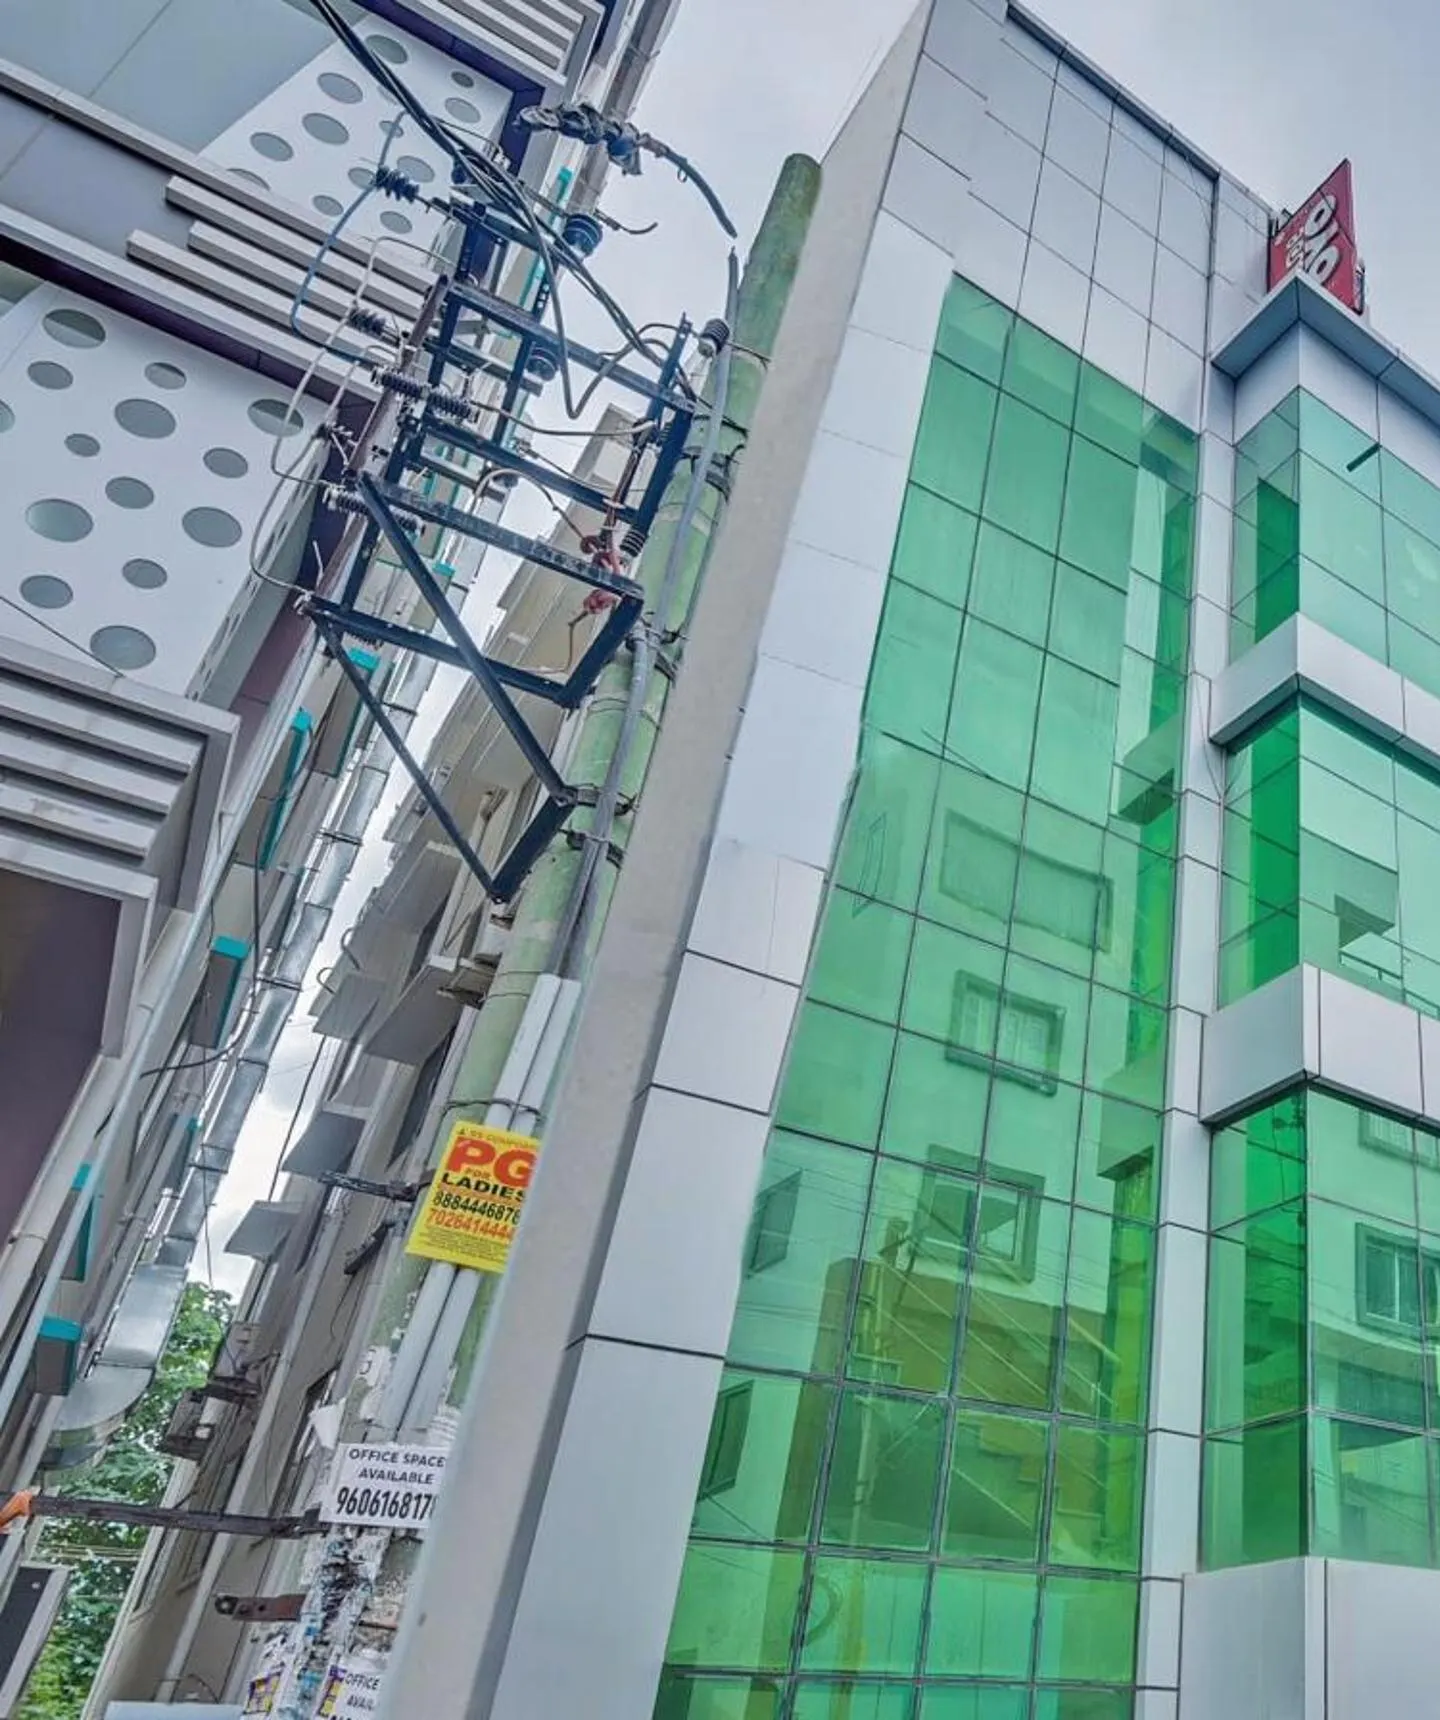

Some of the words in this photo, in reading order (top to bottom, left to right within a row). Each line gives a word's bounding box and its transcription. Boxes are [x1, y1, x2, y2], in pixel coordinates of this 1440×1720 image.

[446, 1136, 538, 1188] PG
[348, 1448, 400, 1464] OFFICE
[402, 1452, 446, 1468] SPACE
[358, 1467, 435, 1485] AVAILABLE
